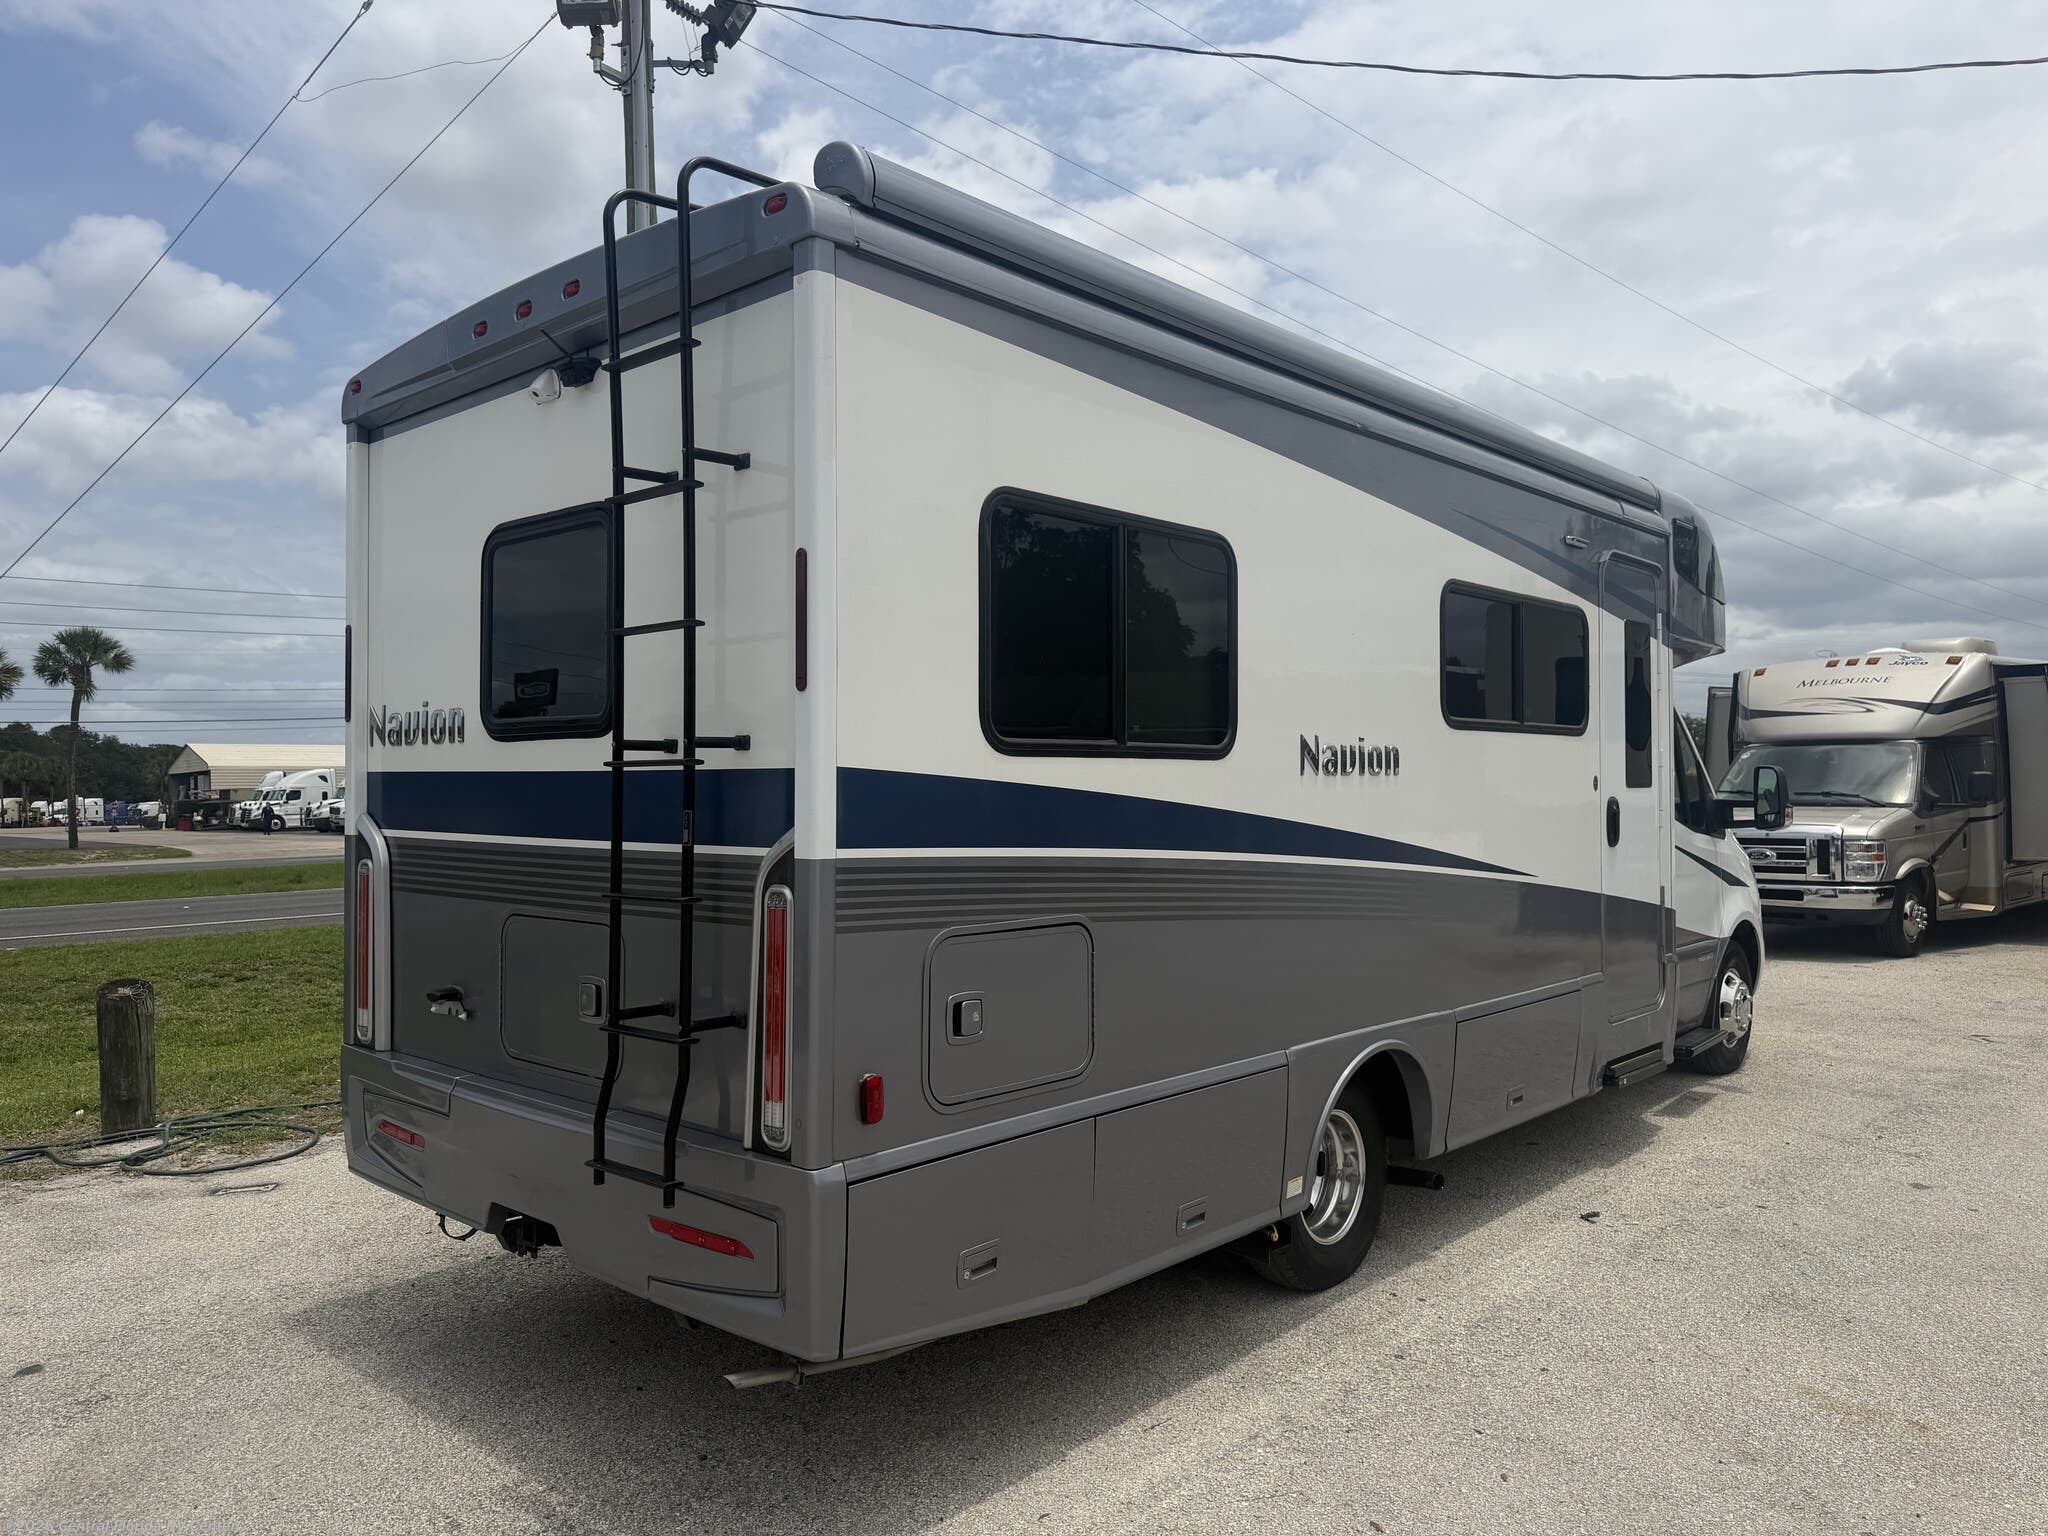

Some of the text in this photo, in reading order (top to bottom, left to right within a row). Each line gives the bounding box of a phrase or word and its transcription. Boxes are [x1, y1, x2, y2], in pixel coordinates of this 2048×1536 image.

[1796, 676, 1893, 689] MELBOURNE
[369, 701, 465, 748] Navion
[1300, 734, 1400, 776] Navion
